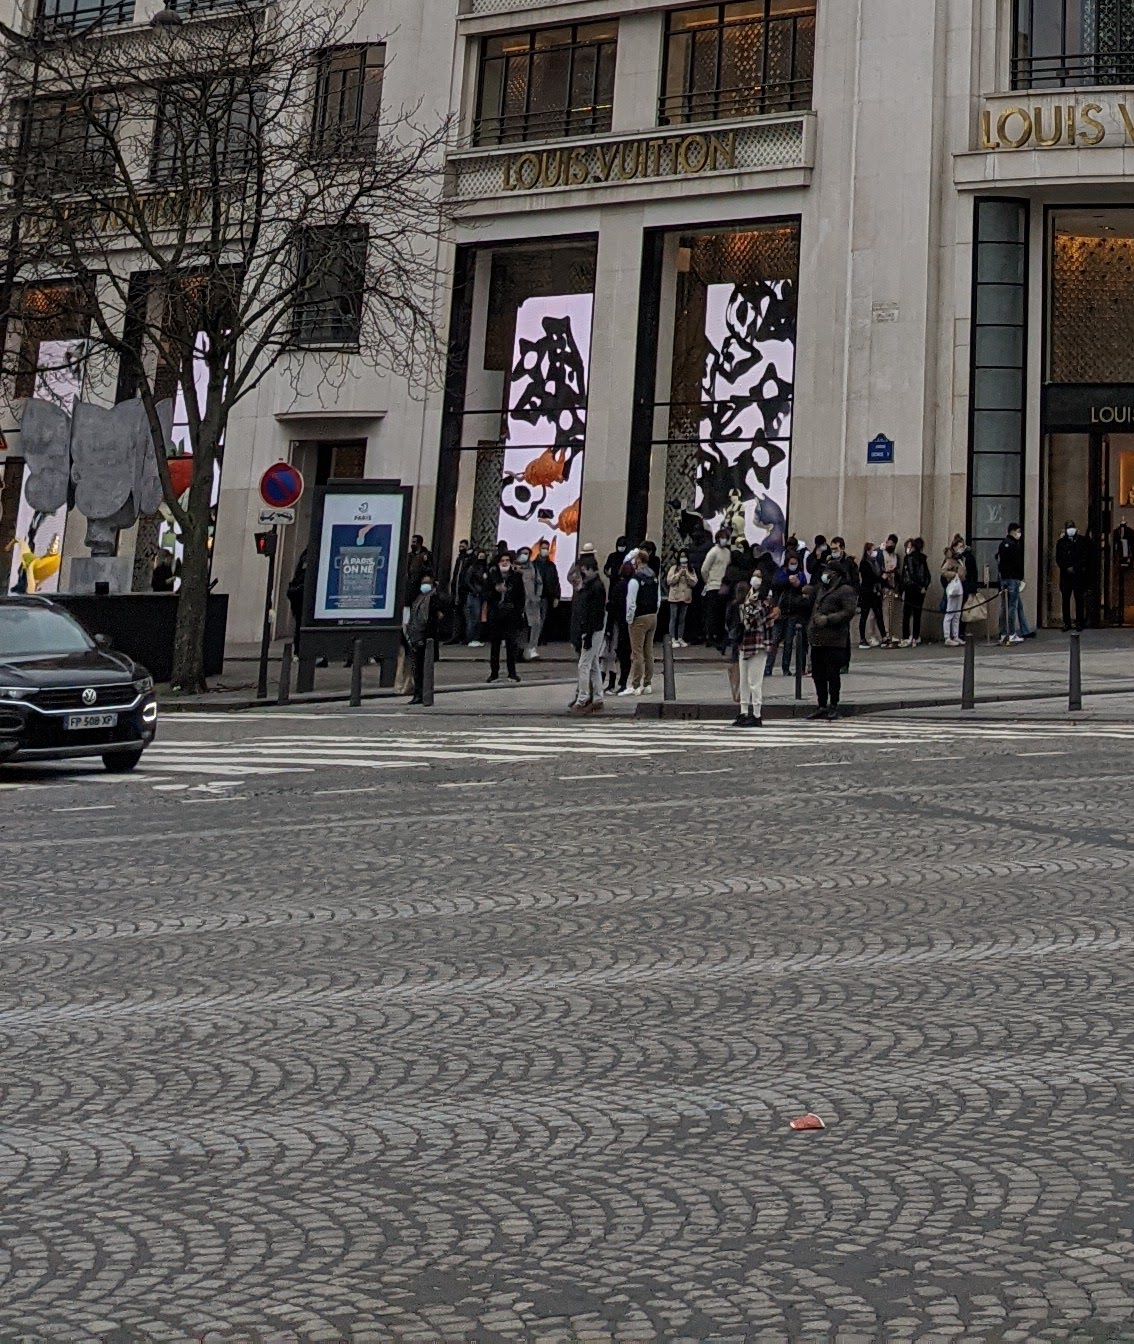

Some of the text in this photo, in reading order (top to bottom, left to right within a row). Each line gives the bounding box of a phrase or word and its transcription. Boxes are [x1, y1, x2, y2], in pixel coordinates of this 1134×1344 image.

[982, 103, 1106, 150] LOUIS
[502, 132, 736, 190] LOUIS VUITTON
[343, 565, 374, 574] ON NE
